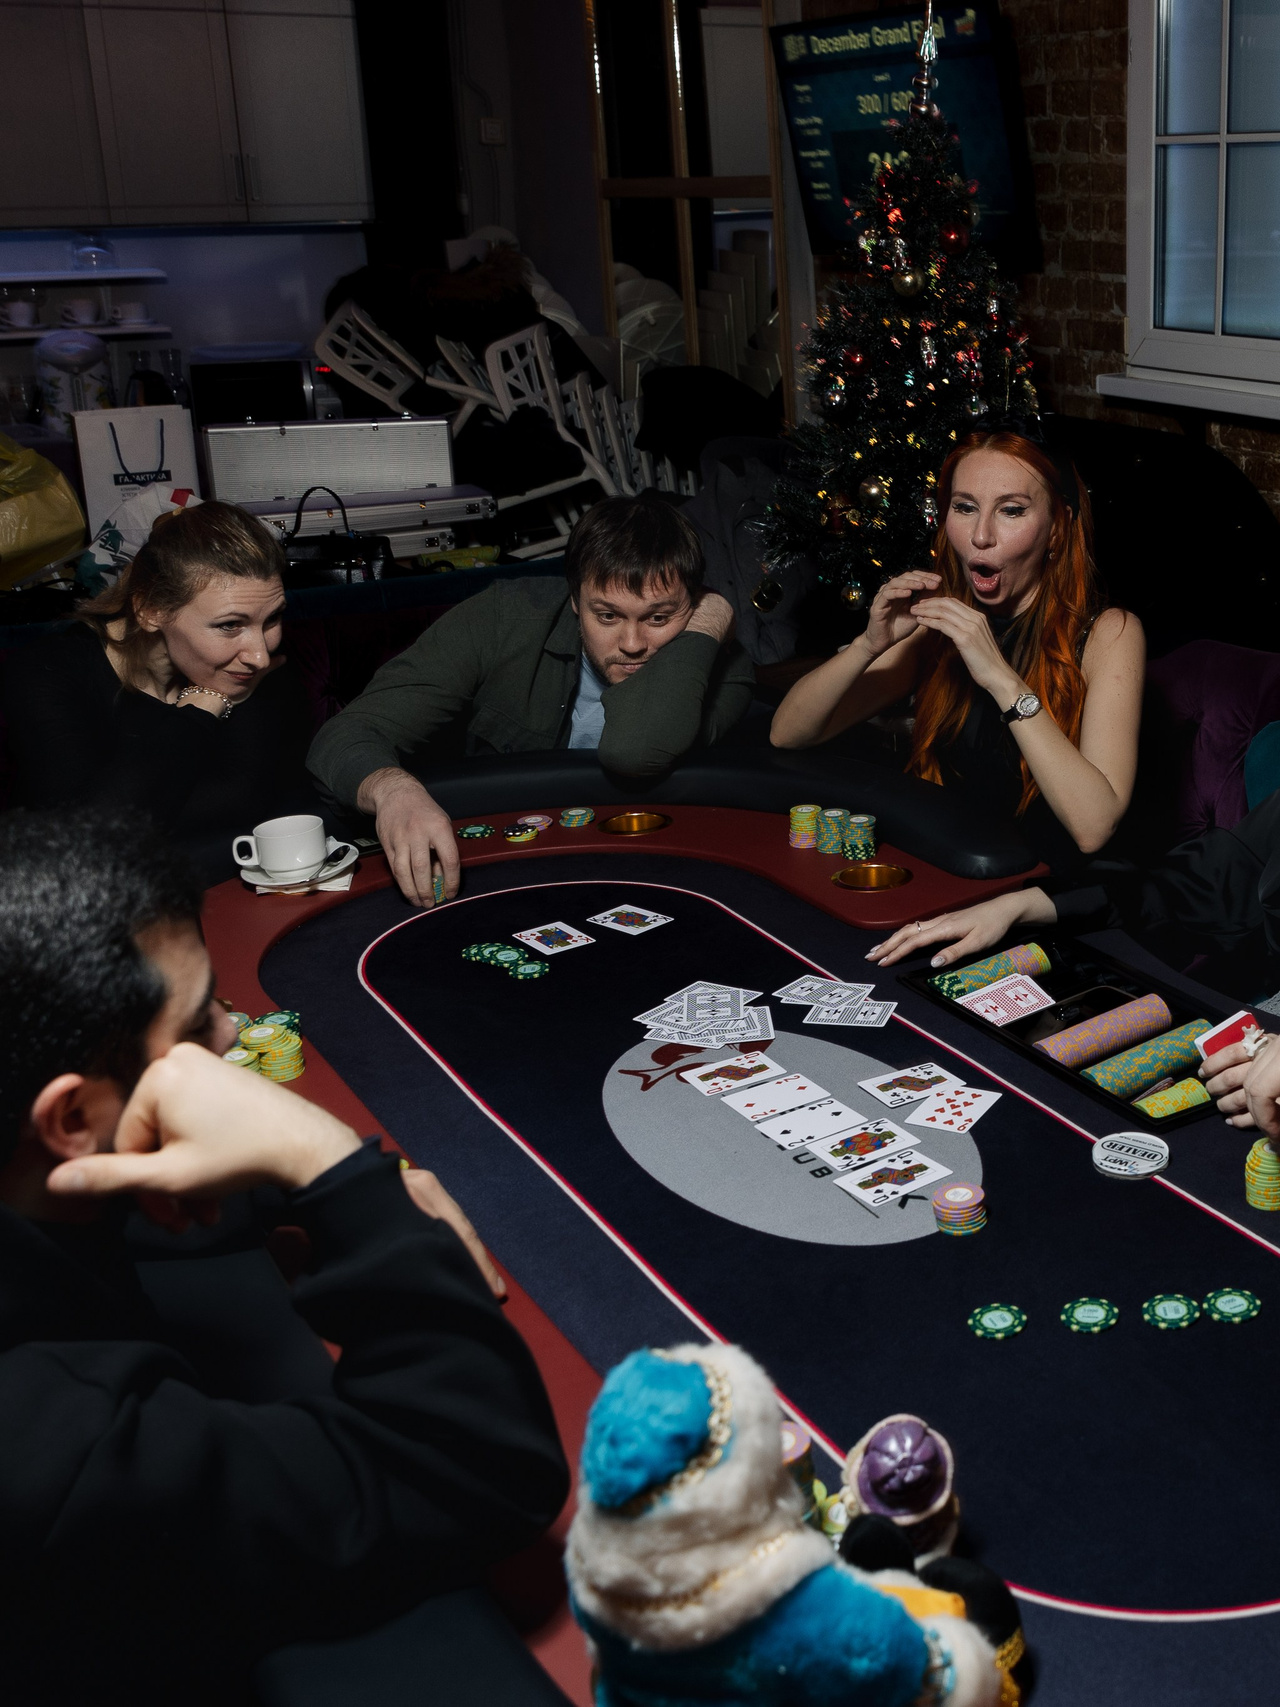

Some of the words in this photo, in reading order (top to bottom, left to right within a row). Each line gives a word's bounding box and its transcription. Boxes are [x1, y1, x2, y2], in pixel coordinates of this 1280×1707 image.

[810, 29, 871, 55] December
[870, 21, 911, 47] Grand
[910, 16, 946, 41] Fal
[857, 94, 881, 115] 300
[783, 1075, 800, 1083] 2
[817, 1100, 834, 1108] 2
[751, 1111, 768, 1119] 2
[868, 1119, 888, 1128] K
[788, 1138, 806, 1147] 2
[897, 1151, 913, 1160] Q
[1106, 1142, 1158, 1160] DEALER
[1101, 1155, 1128, 1166] WPT
[837, 1161, 857, 1170] K
[872, 1195, 889, 1204] Q
